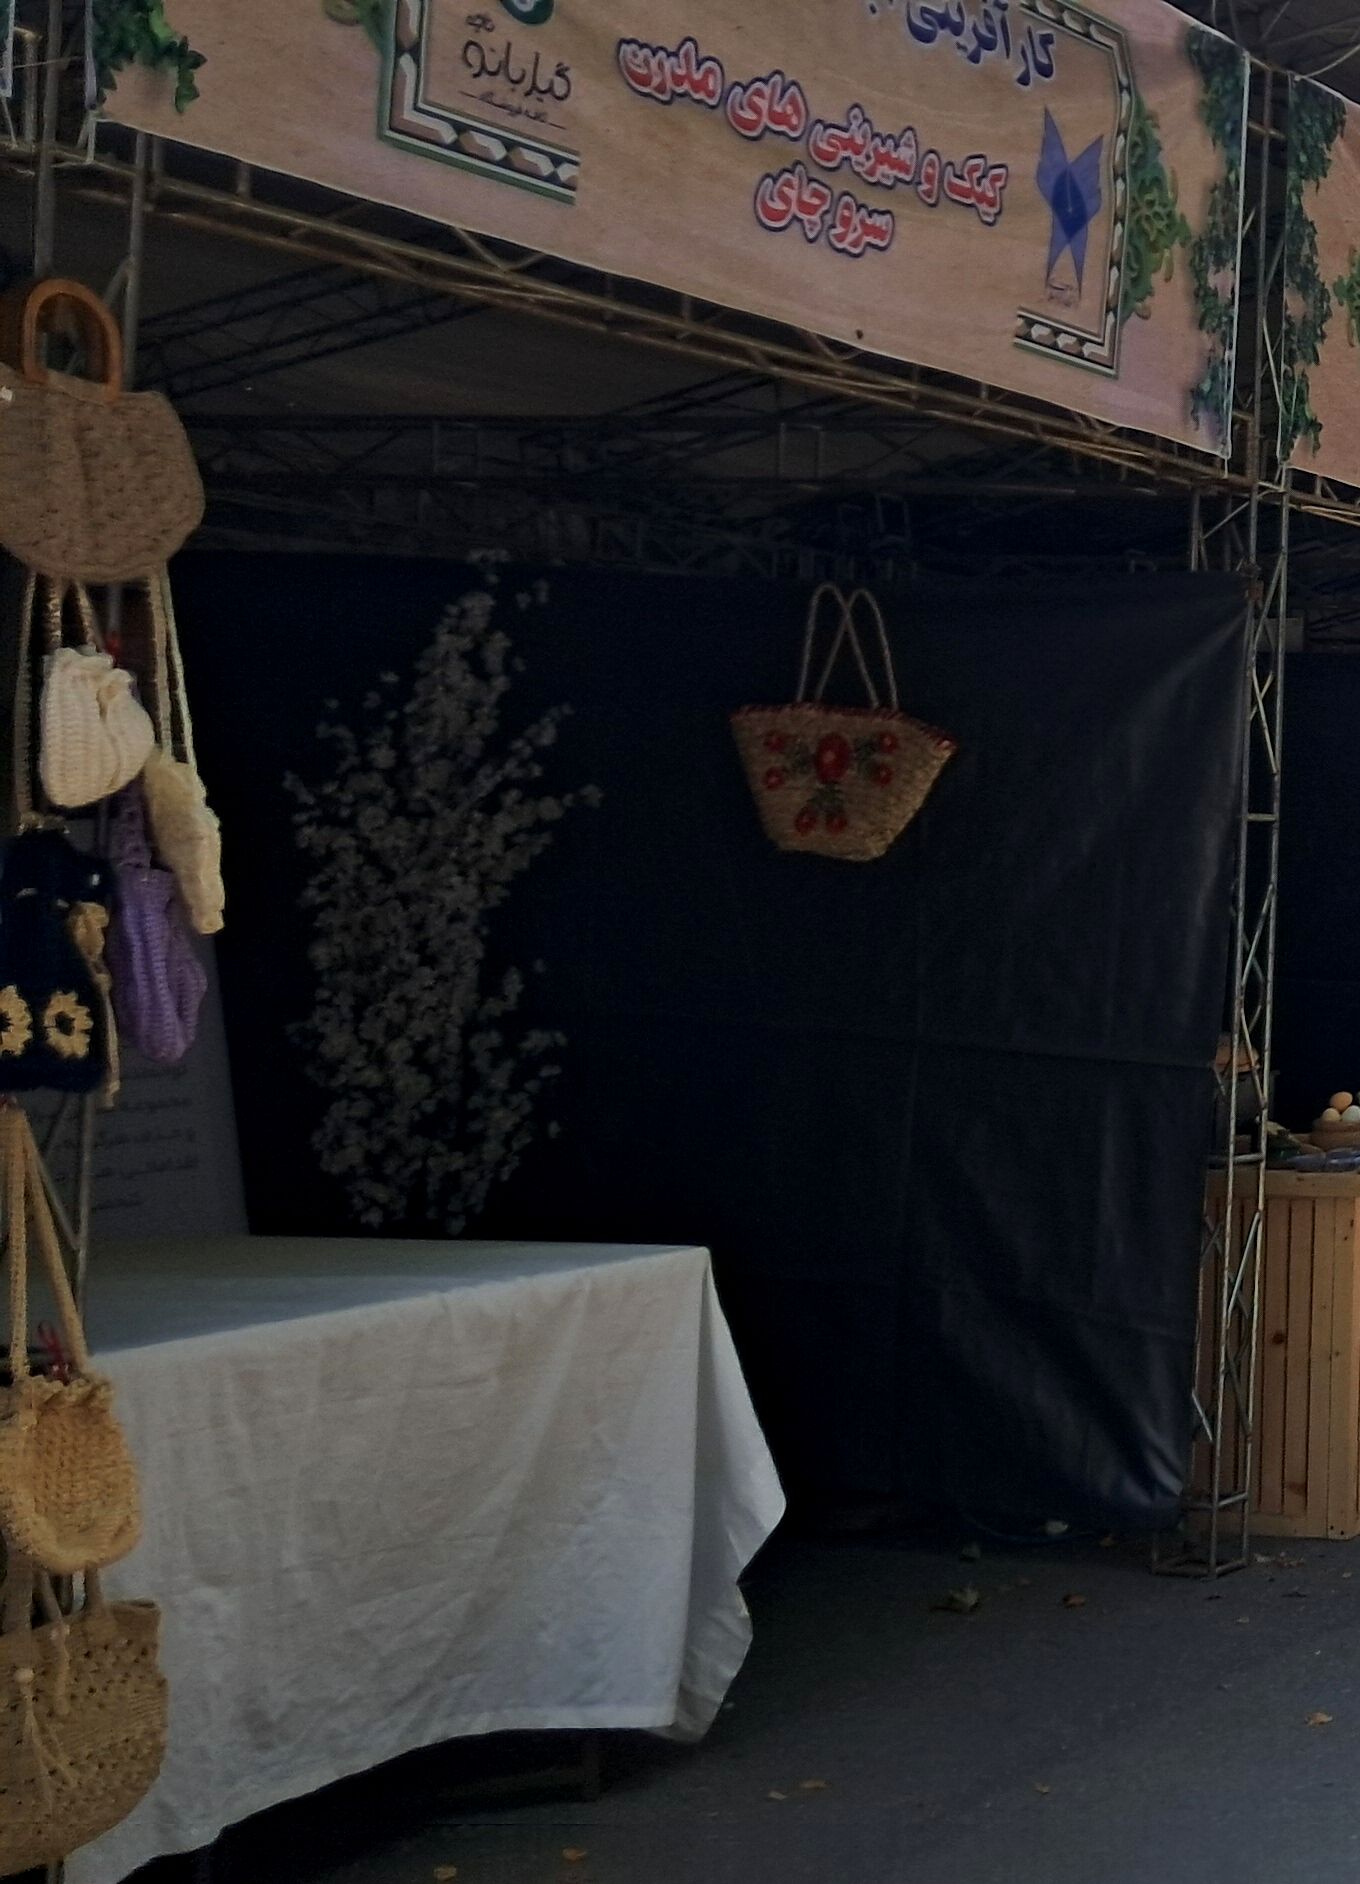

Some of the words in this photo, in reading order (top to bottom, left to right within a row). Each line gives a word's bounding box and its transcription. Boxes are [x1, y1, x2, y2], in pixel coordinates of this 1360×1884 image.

[618, 36, 724, 105] مدرن
[1016, 24, 1055, 87] کار
[726, 70, 807, 139] های
[808, 103, 918, 188] شیرینی
[918, 149, 942, 207] و
[755, 162, 832, 242] چای
[828, 192, 896, 256] سرو
[944, 154, 1008, 225] کیک
